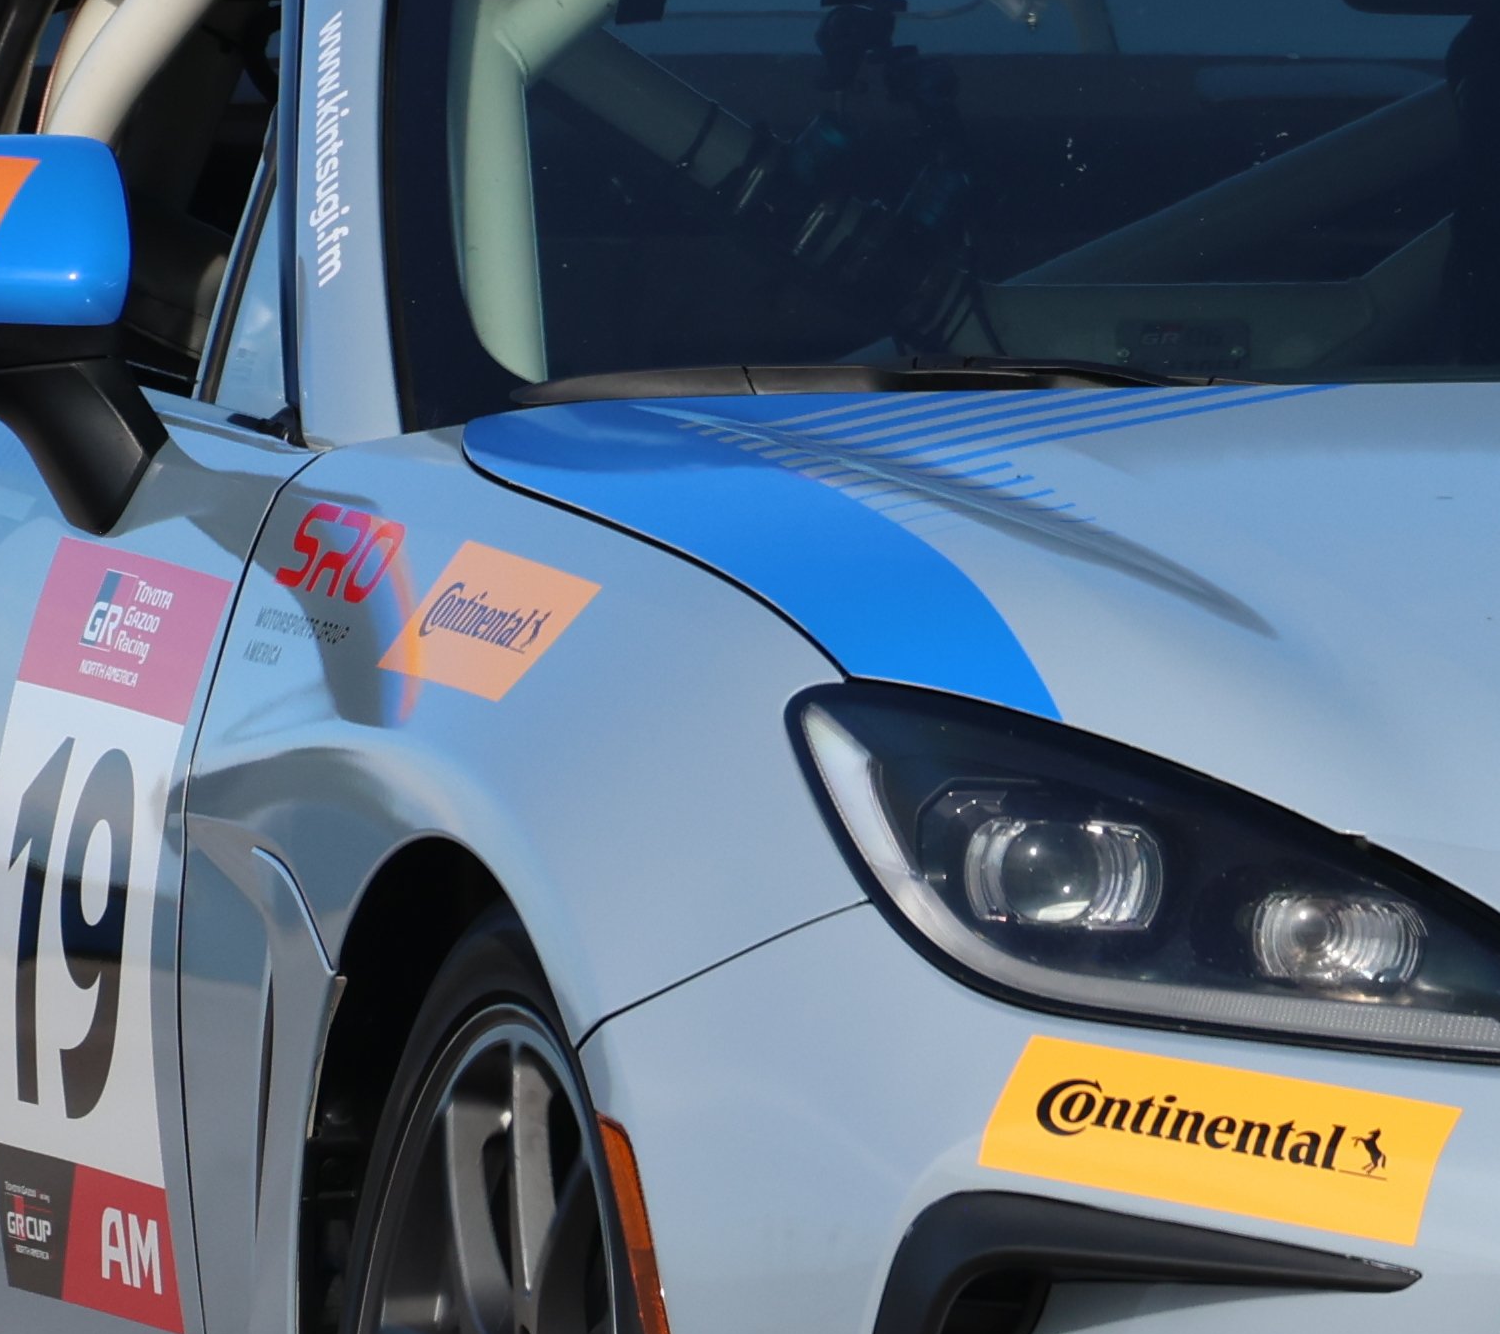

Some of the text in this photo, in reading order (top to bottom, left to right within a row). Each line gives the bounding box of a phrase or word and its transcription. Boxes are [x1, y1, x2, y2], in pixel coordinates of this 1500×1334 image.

[308, 10, 350, 289] www.kintsugi.fm
[82, 600, 124, 647] GR
[418, 581, 540, 649] Continental
[7, 736, 136, 1120] 19
[1035, 1078, 1347, 1171] Continental
[6, 1211, 53, 1244] GR CUP
[101, 1207, 163, 1296] AM
